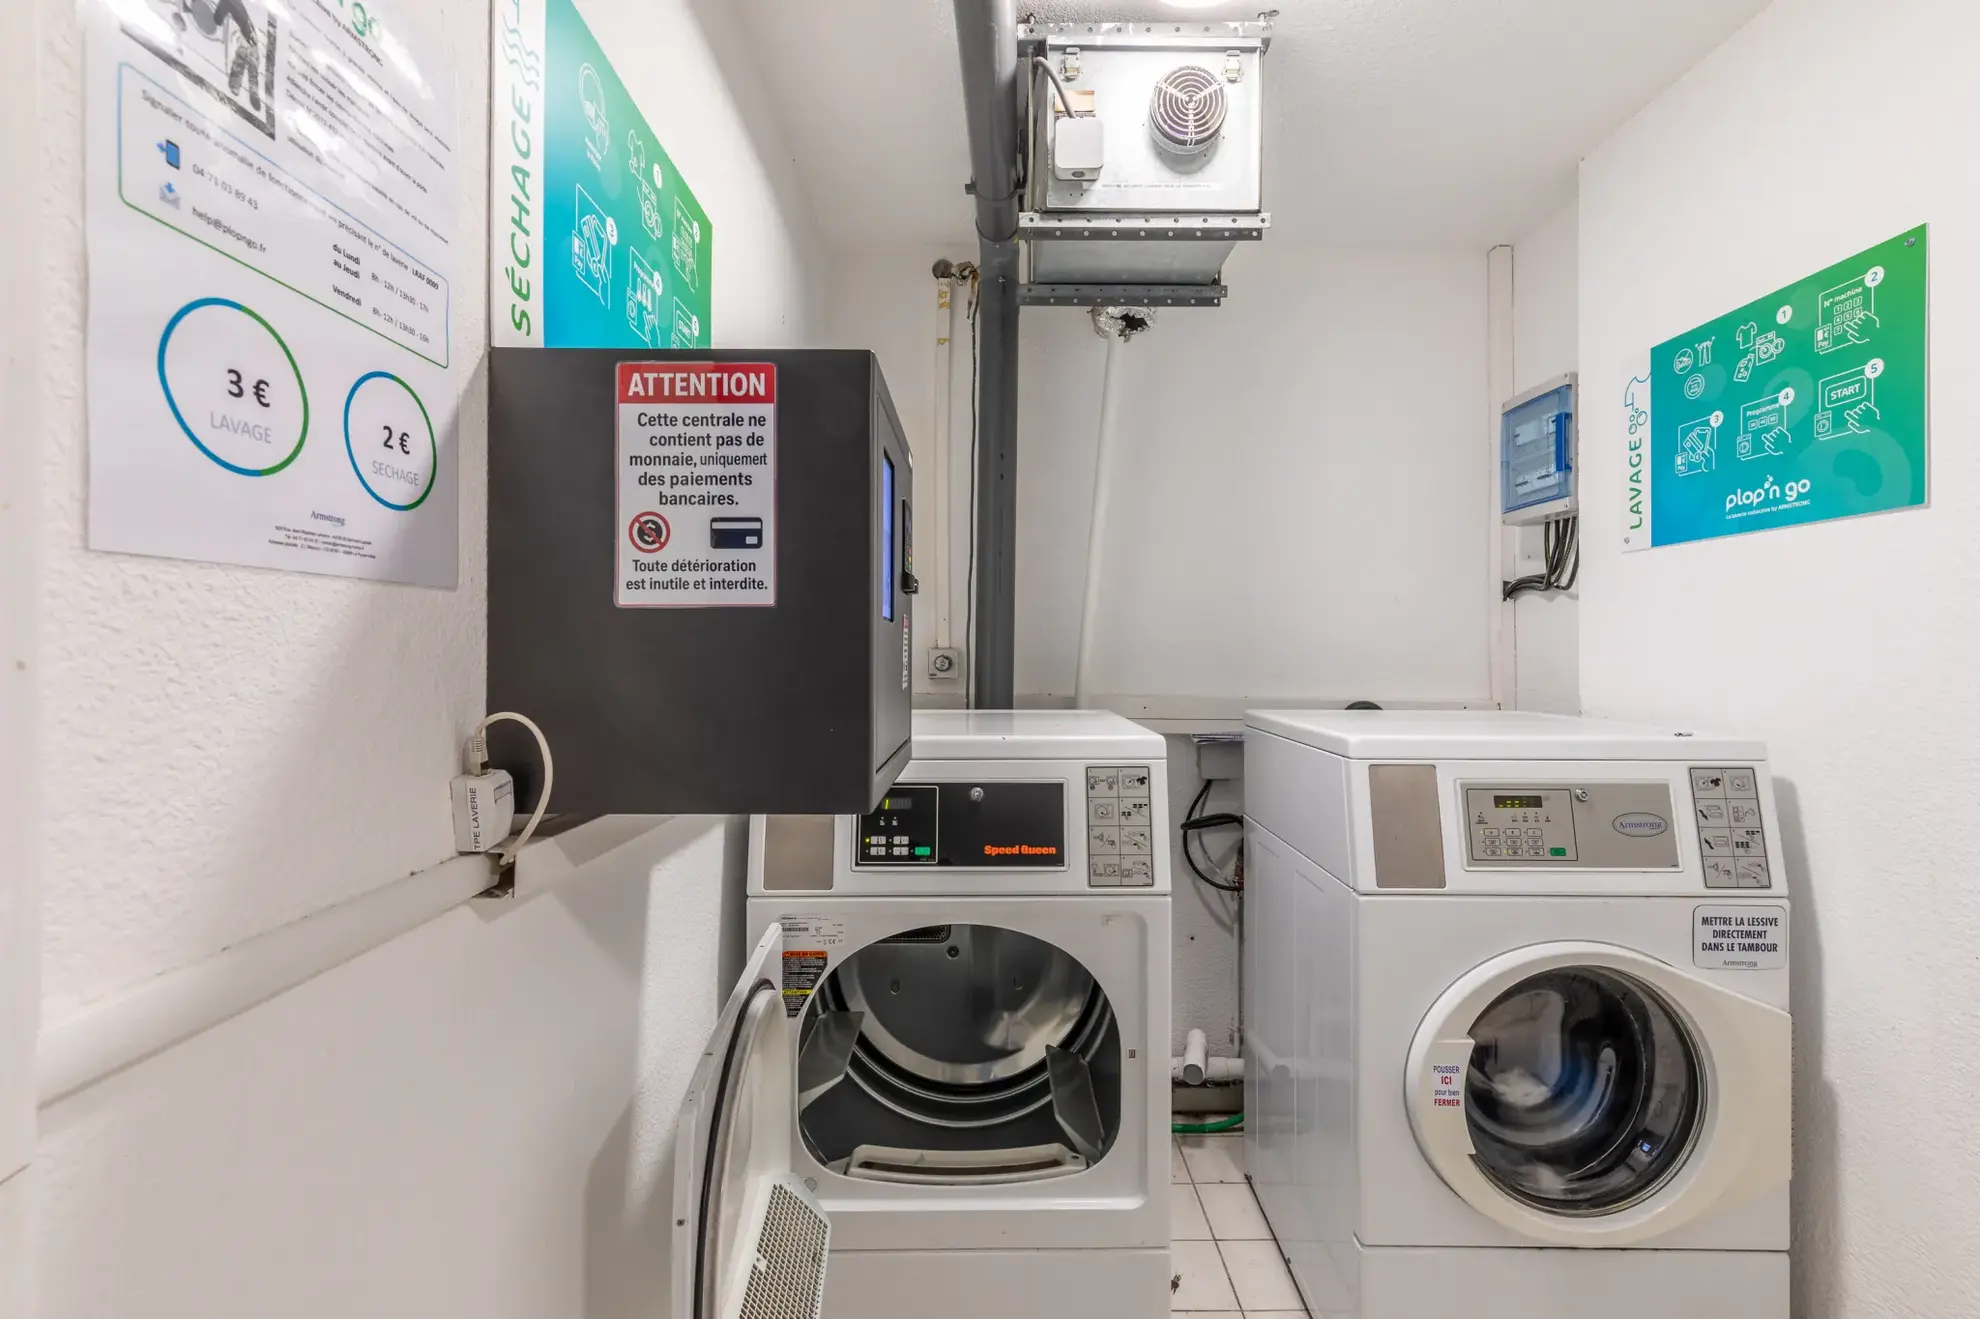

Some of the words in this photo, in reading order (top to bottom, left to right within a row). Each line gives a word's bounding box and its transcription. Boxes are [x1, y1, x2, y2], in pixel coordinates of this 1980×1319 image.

[256, 166, 267, 179] de
[505, 84, 531, 336] SÉCHAGE
[192, 205, 267, 253] help@plopngo.fr
[332, 243, 341, 254] du
[342, 248, 361, 266] Lundi
[333, 259, 342, 269] au
[343, 263, 360, 280] Jeudi
[1871, 271, 1878, 282] 2
[332, 284, 362, 307] Vendredi
[1834, 287, 1863, 302] machine
[1781, 309, 1787, 320] 1
[1818, 340, 1829, 349] Pay
[1870, 363, 1878, 374] 5
[227, 368, 244, 398] 3
[252, 379, 271, 408] €
[628, 372, 765, 396] ATTENTION
[1830, 383, 1861, 400] START
[1783, 391, 1790, 400] 4
[1746, 402, 1780, 417] Programme
[637, 412, 678, 427] Cette
[682, 412, 744, 427] centrale
[748, 415, 766, 427] ne
[210, 411, 272, 444] LAVAGE
[383, 425, 394, 450] 2
[399, 432, 410, 455] €
[649, 433, 712, 447] contient
[716, 435, 742, 450] pas
[746, 432, 765, 447] de
[629, 452, 697, 468] monnaie,
[372, 460, 421, 487] SECHAGE
[638, 472, 666, 486] des
[670, 472, 753, 489] paiements
[1629, 438, 1642, 530] LAVAGE
[1785, 479, 1811, 502] go
[659, 491, 739, 506] bancaires.
[1778, 499, 1811, 511] ARMSTRONG
[310, 510, 345, 526] Armstrong
[632, 560, 668, 572] Toute
[671, 559, 756, 572] détérioration
[625, 579, 646, 590] est
[649, 577, 690, 590] inutile
[693, 579, 706, 590] et
[709, 577, 768, 590] interdite.
[469, 787, 480, 829] LAVERIE
[1619, 821, 1663, 829] Armstrong
[473, 832, 481, 850] TPE
[984, 844, 1020, 856] Speed
[1021, 844, 1056, 855] Queen
[1701, 916, 1733, 926] METTRE
[1735, 917, 1745, 926] LA
[1747, 917, 1779, 927] LESSIVE
[1712, 929, 1768, 939] DIRECTEMENT
[1701, 942, 1724, 951] DANS
[1726, 943, 1735, 951] LE
[1737, 943, 1778, 952] TAMBOUR
[1722, 960, 1758, 968] Armstrong
[1433, 1065, 1460, 1074] POUSSER
[1441, 1075, 1452, 1085] ICI
[1434, 1098, 1460, 1107] FERMER
